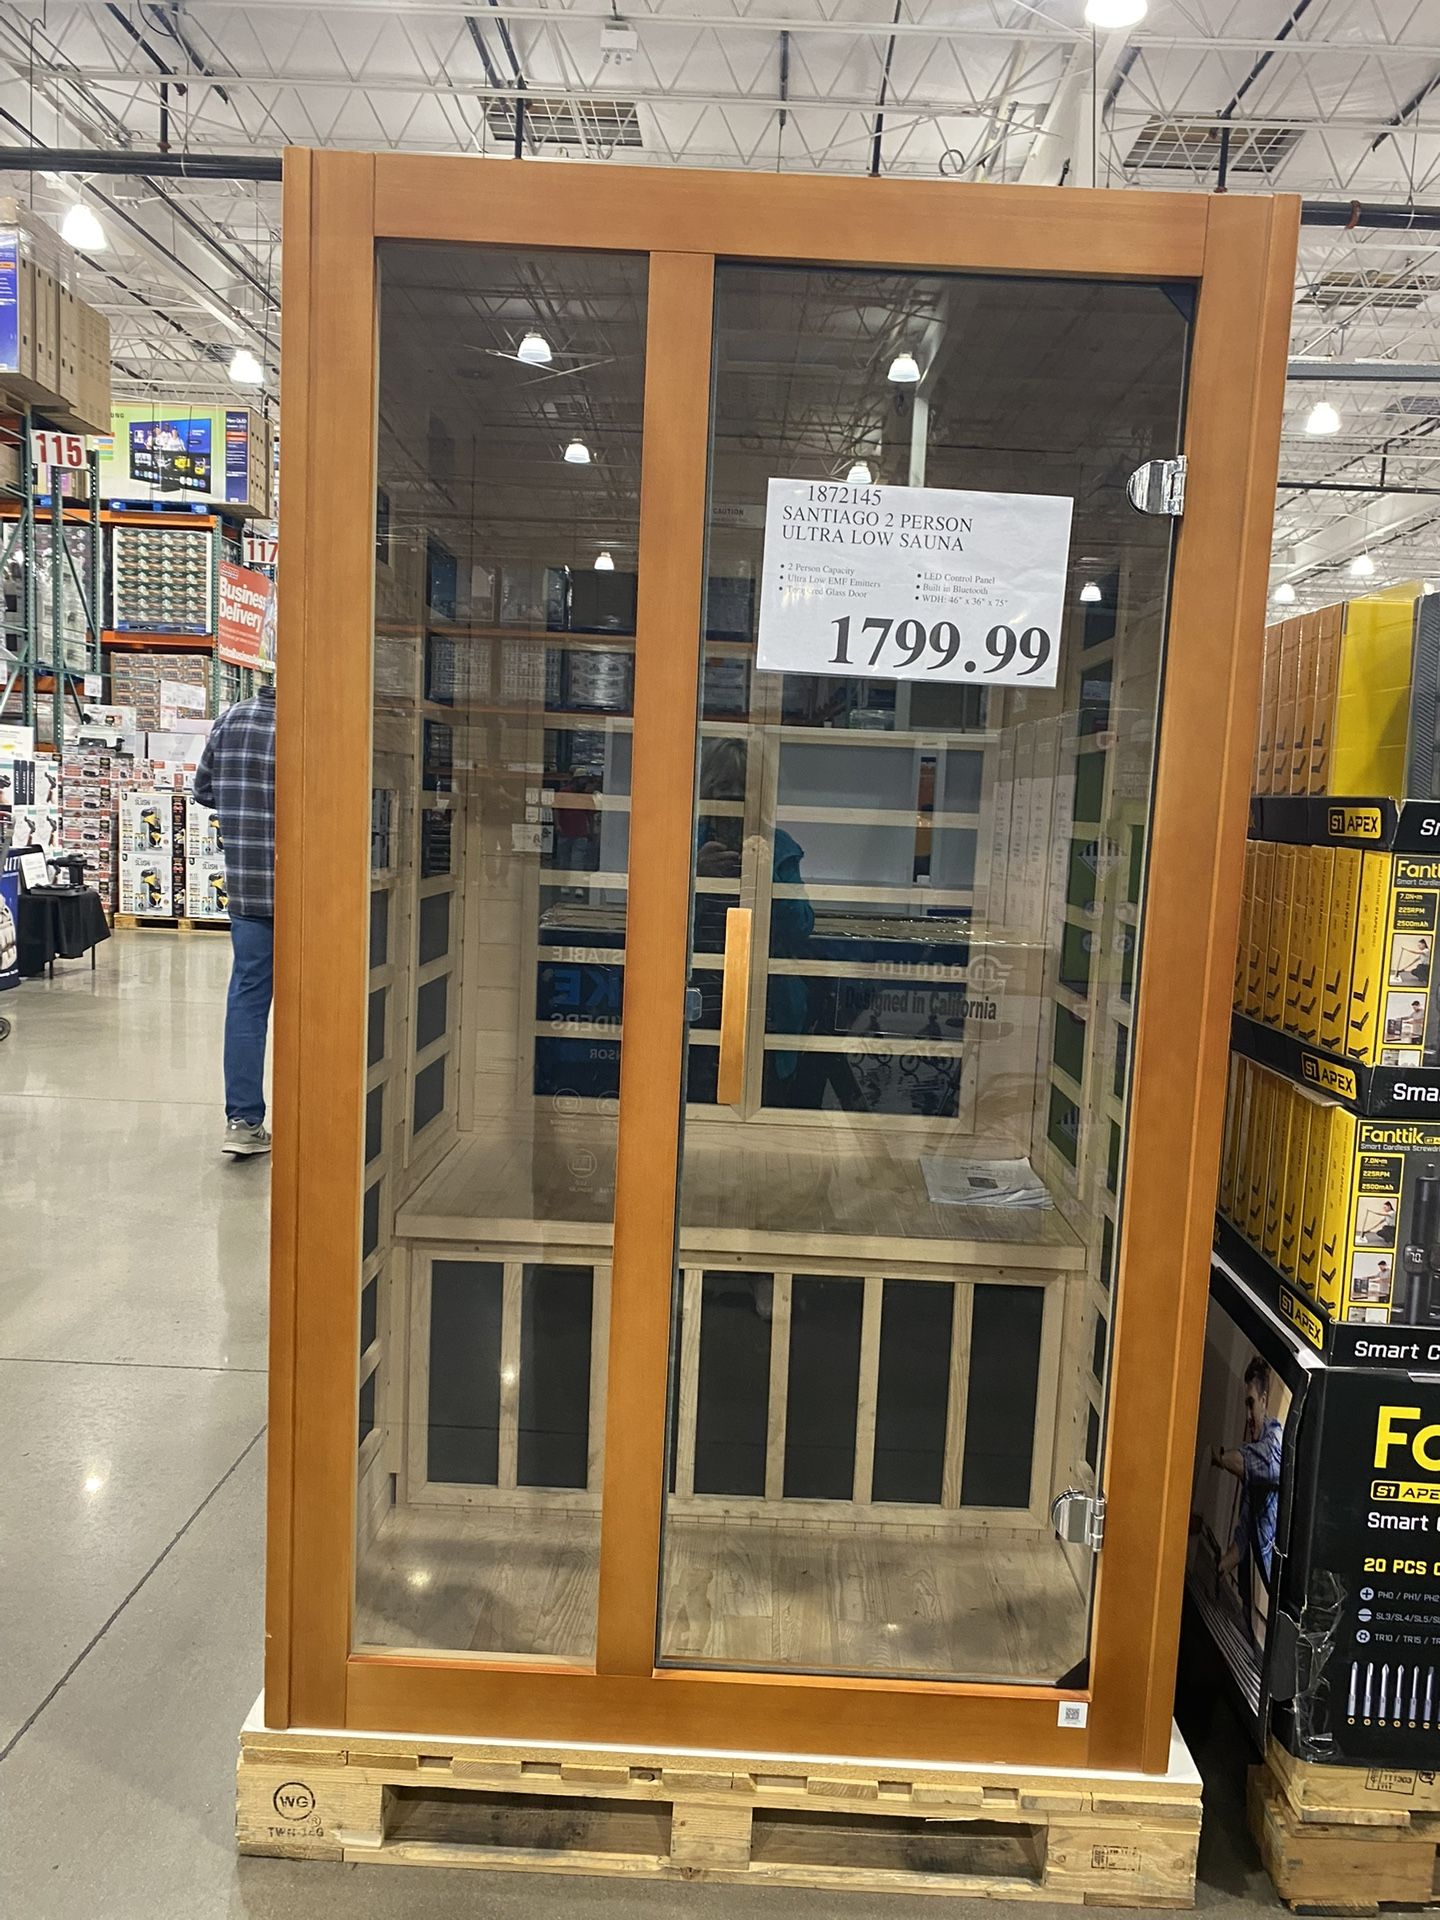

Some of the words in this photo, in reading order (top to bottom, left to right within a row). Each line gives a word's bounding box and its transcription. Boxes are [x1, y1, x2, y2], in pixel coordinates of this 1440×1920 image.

[35, 434, 83, 467] 115
[808, 485, 882, 506] 1872145
[783, 505, 879, 526] SANTIAGO
[885, 513, 894, 527] 2
[900, 514, 973, 533] PERSON
[783, 525, 843, 543] ULTRA
[851, 530, 894, 546] LOW
[900, 533, 964, 551] SAUNA
[247, 540, 278, 562] 117
[788, 563, 793, 571] 2
[795, 563, 820, 573] Person
[822, 565, 855, 576] Capacity
[924, 572, 942, 581] LED
[944, 573, 972, 583] Control
[975, 575, 995, 585] Panel
[788, 574, 806, 583] Ultra
[809, 574, 825, 584] Low
[828, 577, 848, 585] EMF
[850, 578, 880, 588] Emitters
[923, 583, 941, 592] Built
[943, 584, 951, 592] in
[953, 585, 988, 595] Bluetooth
[220, 576, 267, 611] Business
[825, 588, 846, 597] Glass
[848, 589, 867, 598] Door
[220, 597, 263, 633] Delivery
[828, 615, 1051, 676] 1799.99
[1331, 815, 1343, 831] S1
[1347, 816, 1378, 833] APEX
[913, 992, 925, 1014] in
[929, 990, 997, 1020] California
[1305, 1060, 1317, 1078] S1
[1322, 1068, 1353, 1093] APEX
[1361, 1126, 1424, 1144] Fanttik
[1281, 1294, 1292, 1314] S1
[1294, 1310, 1322, 1343] APEX
[1354, 1340, 1419, 1360] Smart
[1376, 1486, 1396, 1497] S1
[1367, 1512, 1428, 1531] Smart
[1363, 1557, 1387, 1573] 20
[1393, 1559, 1427, 1575] PCS
[1374, 1633, 1393, 1641] TR10
[1403, 1634, 1421, 1644] TR15
[280, 1796, 308, 1808] WG
